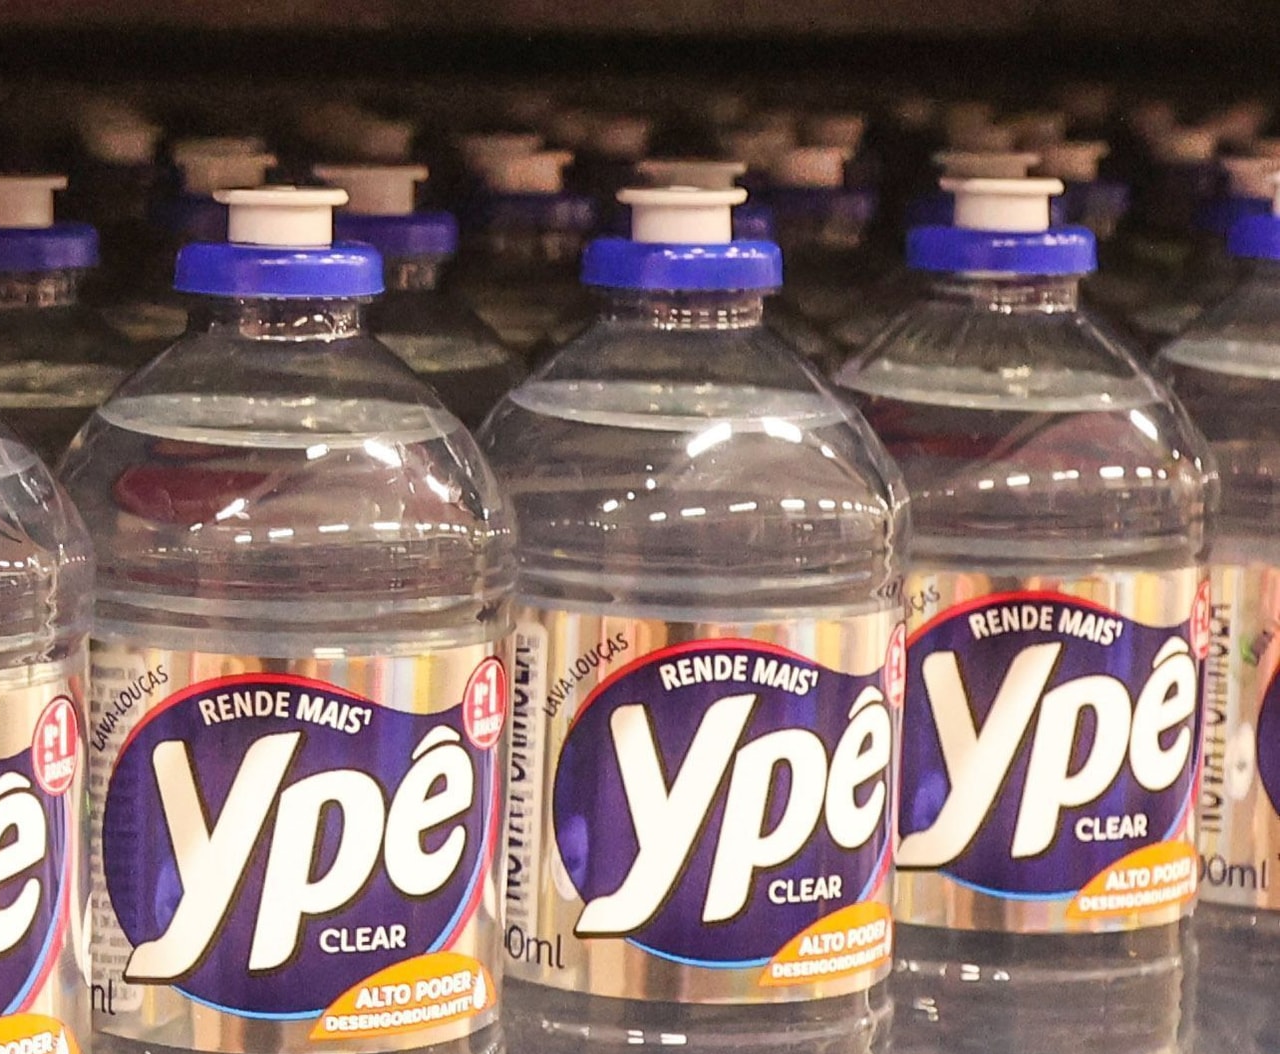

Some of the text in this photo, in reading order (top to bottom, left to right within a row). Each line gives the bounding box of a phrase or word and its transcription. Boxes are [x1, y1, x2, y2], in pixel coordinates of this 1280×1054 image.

[968, 606, 1053, 640] RENDE
[544, 631, 629, 718] LAVA-LOUÇAS
[659, 655, 749, 691] RENDE
[92, 664, 169, 752] LAVA-LOUÇAS
[198, 691, 290, 727] RENDE
[894, 636, 1199, 870] Ypê
[574, 685, 892, 936] Ypê
[1075, 813, 1148, 842] CLEAR
[124, 725, 475, 982] Ypê
[768, 875, 842, 905] CLEAR
[1105, 865, 1151, 891] ALTO
[319, 924, 407, 954] CLEAR
[504, 924, 565, 970] 0ml
[798, 918, 887, 957] ALTO PODER
[355, 969, 473, 1009] ALTO PODER
